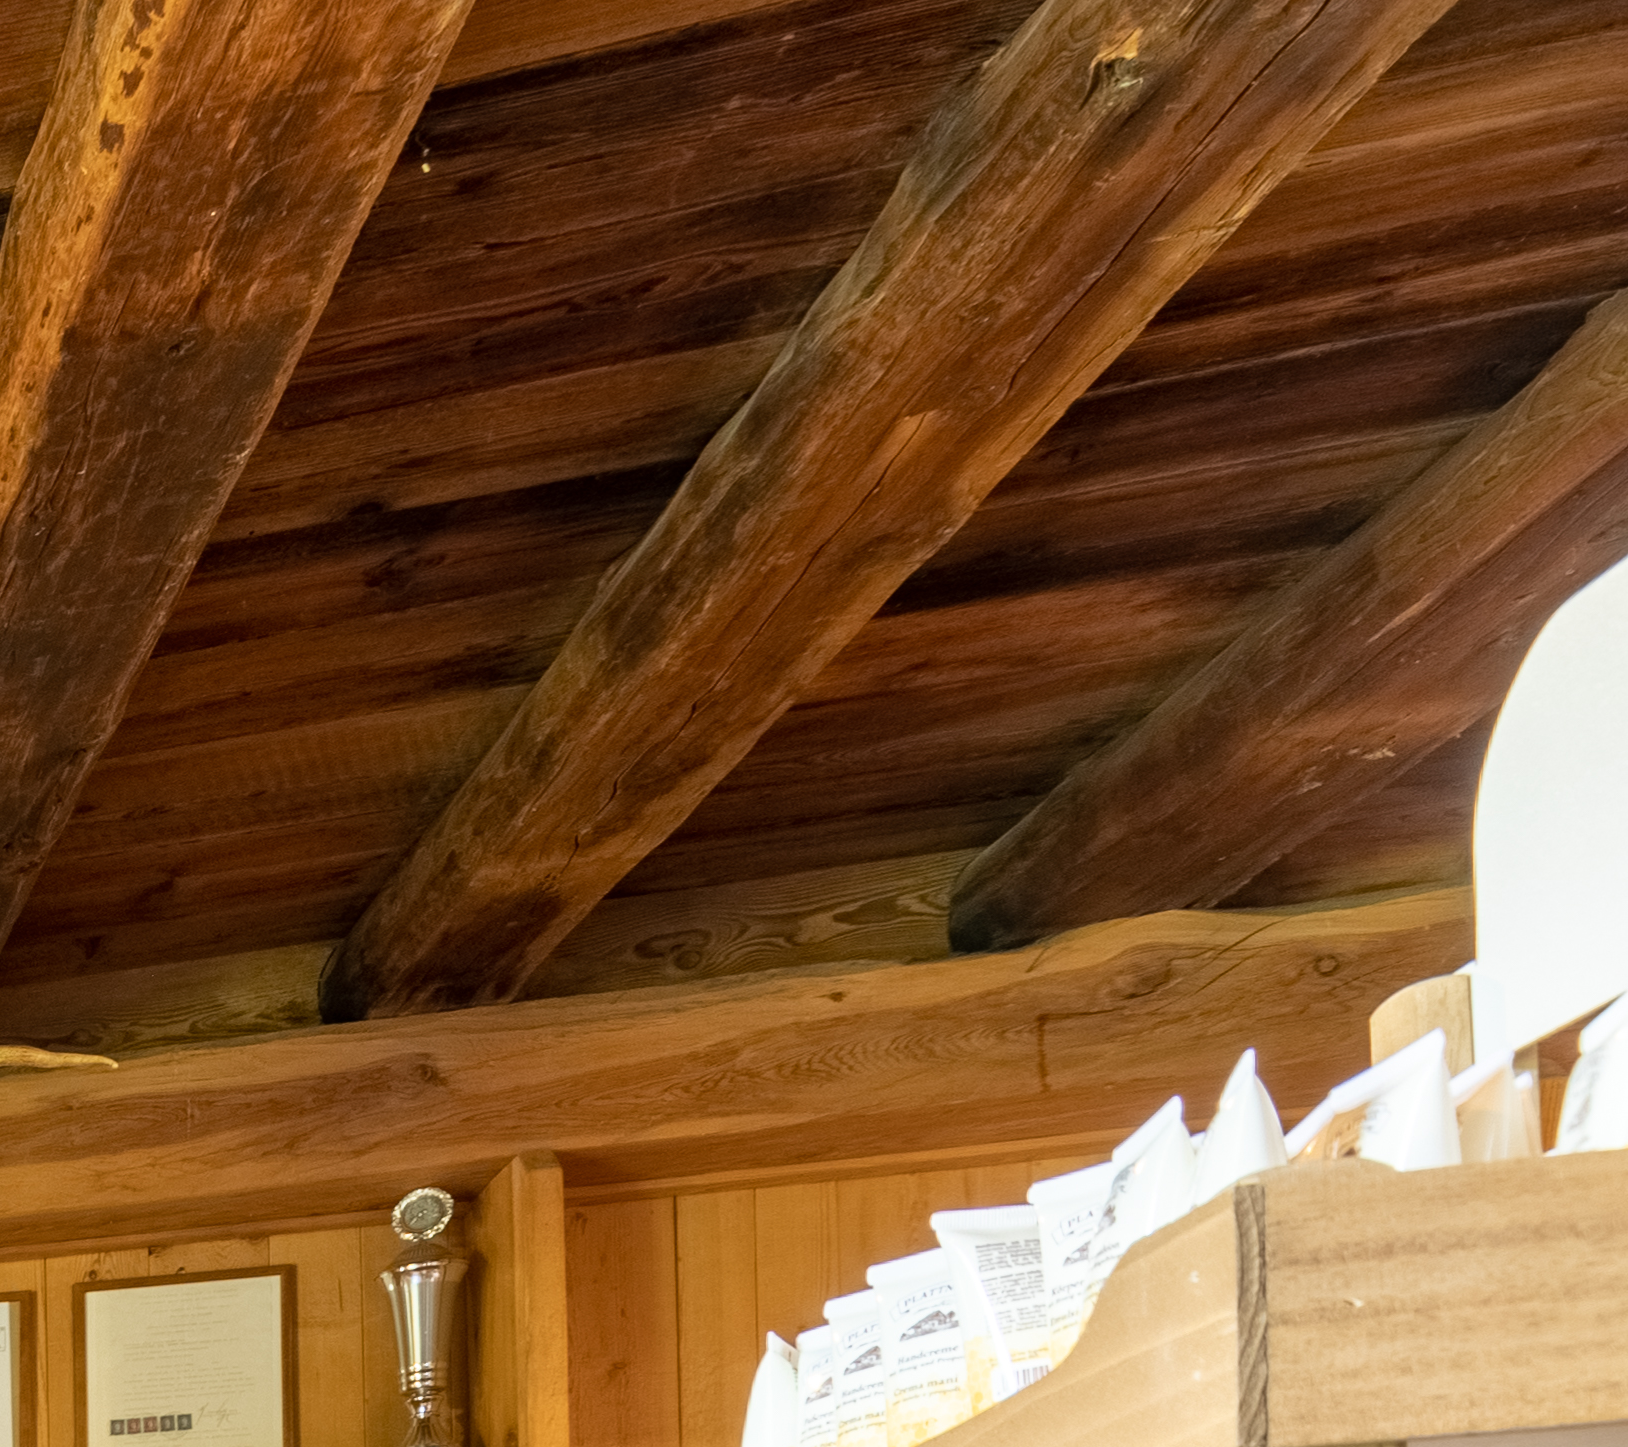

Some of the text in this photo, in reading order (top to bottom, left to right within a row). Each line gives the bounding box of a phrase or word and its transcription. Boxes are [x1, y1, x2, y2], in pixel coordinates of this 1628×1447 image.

[903, 1284, 952, 1307] PLATTN
[898, 1345, 959, 1366] Handcreme
[893, 1376, 958, 1397] Crema mani
